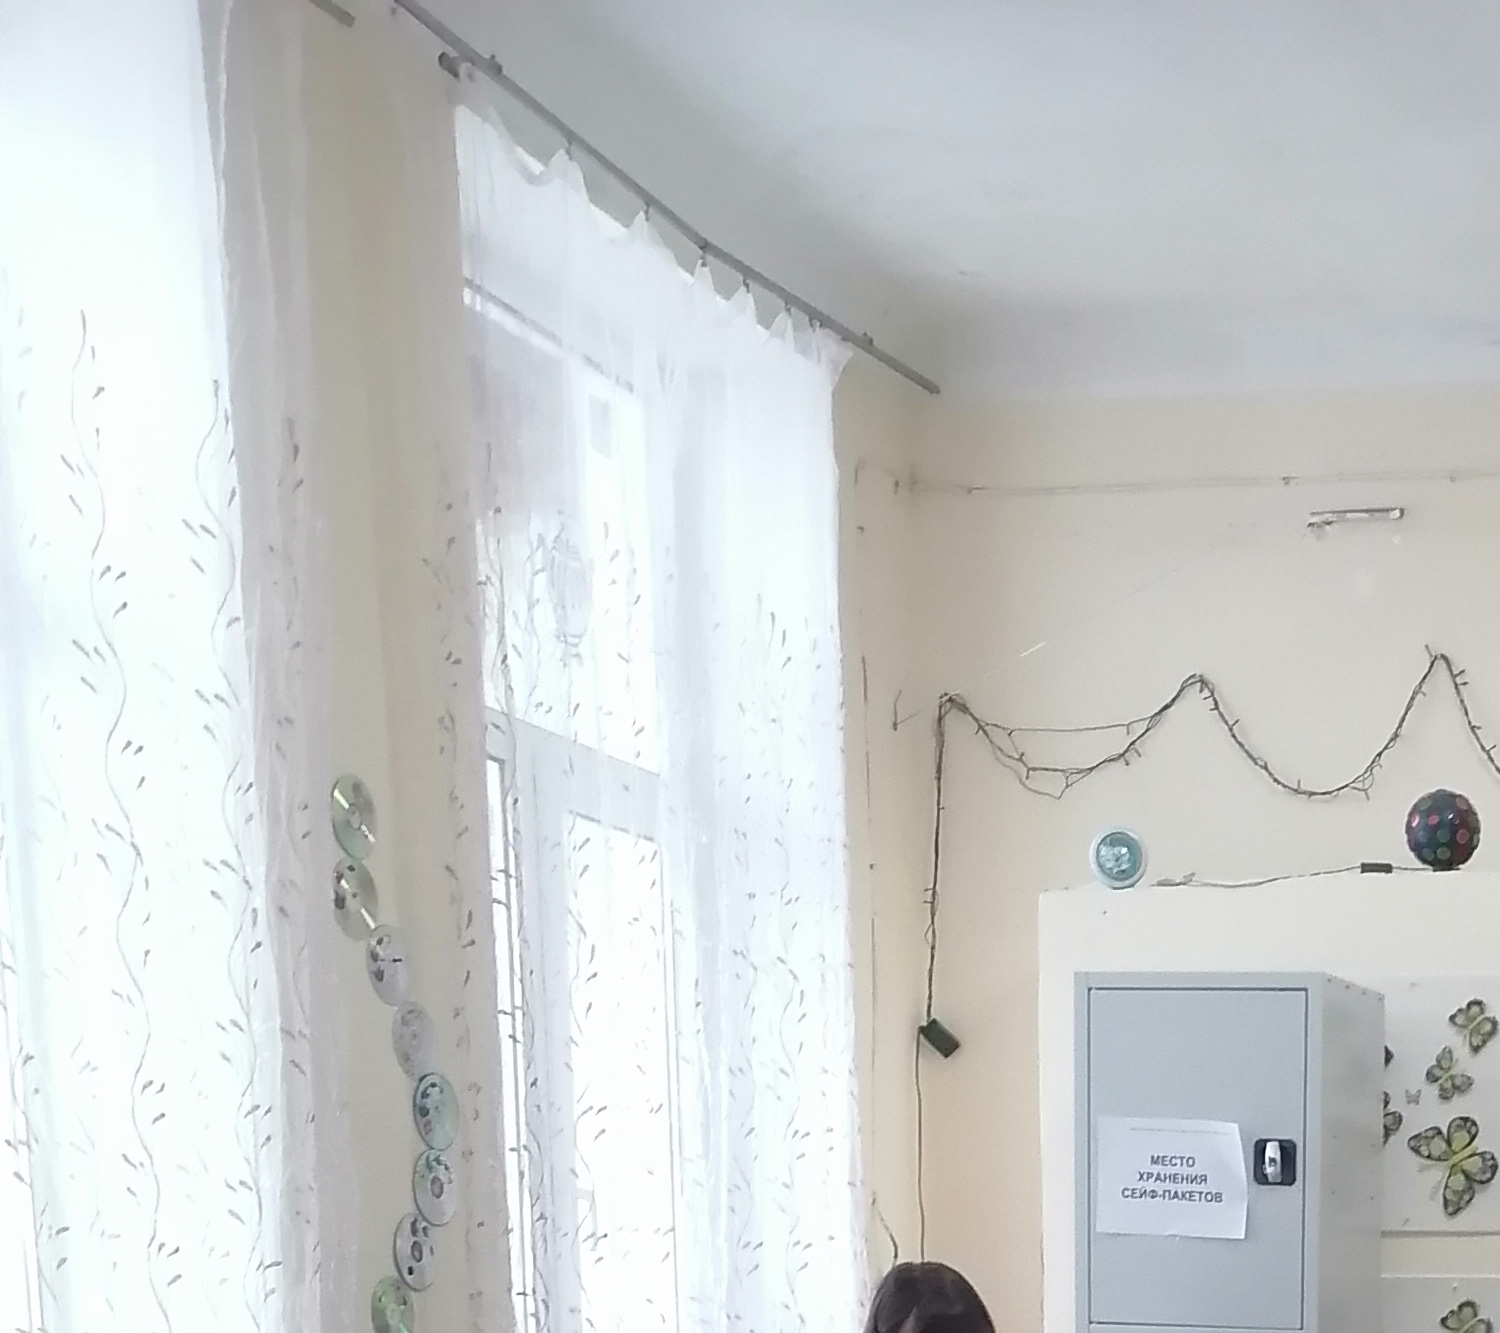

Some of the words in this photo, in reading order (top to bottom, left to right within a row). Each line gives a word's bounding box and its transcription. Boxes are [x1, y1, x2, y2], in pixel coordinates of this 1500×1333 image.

[1150, 1155, 1196, 1168] МЕСТО
[1137, 1171, 1208, 1185] ХРАНЕНИЯ
[1121, 1187, 1224, 1204] СЕЙФ-ПАКЕТОВ
